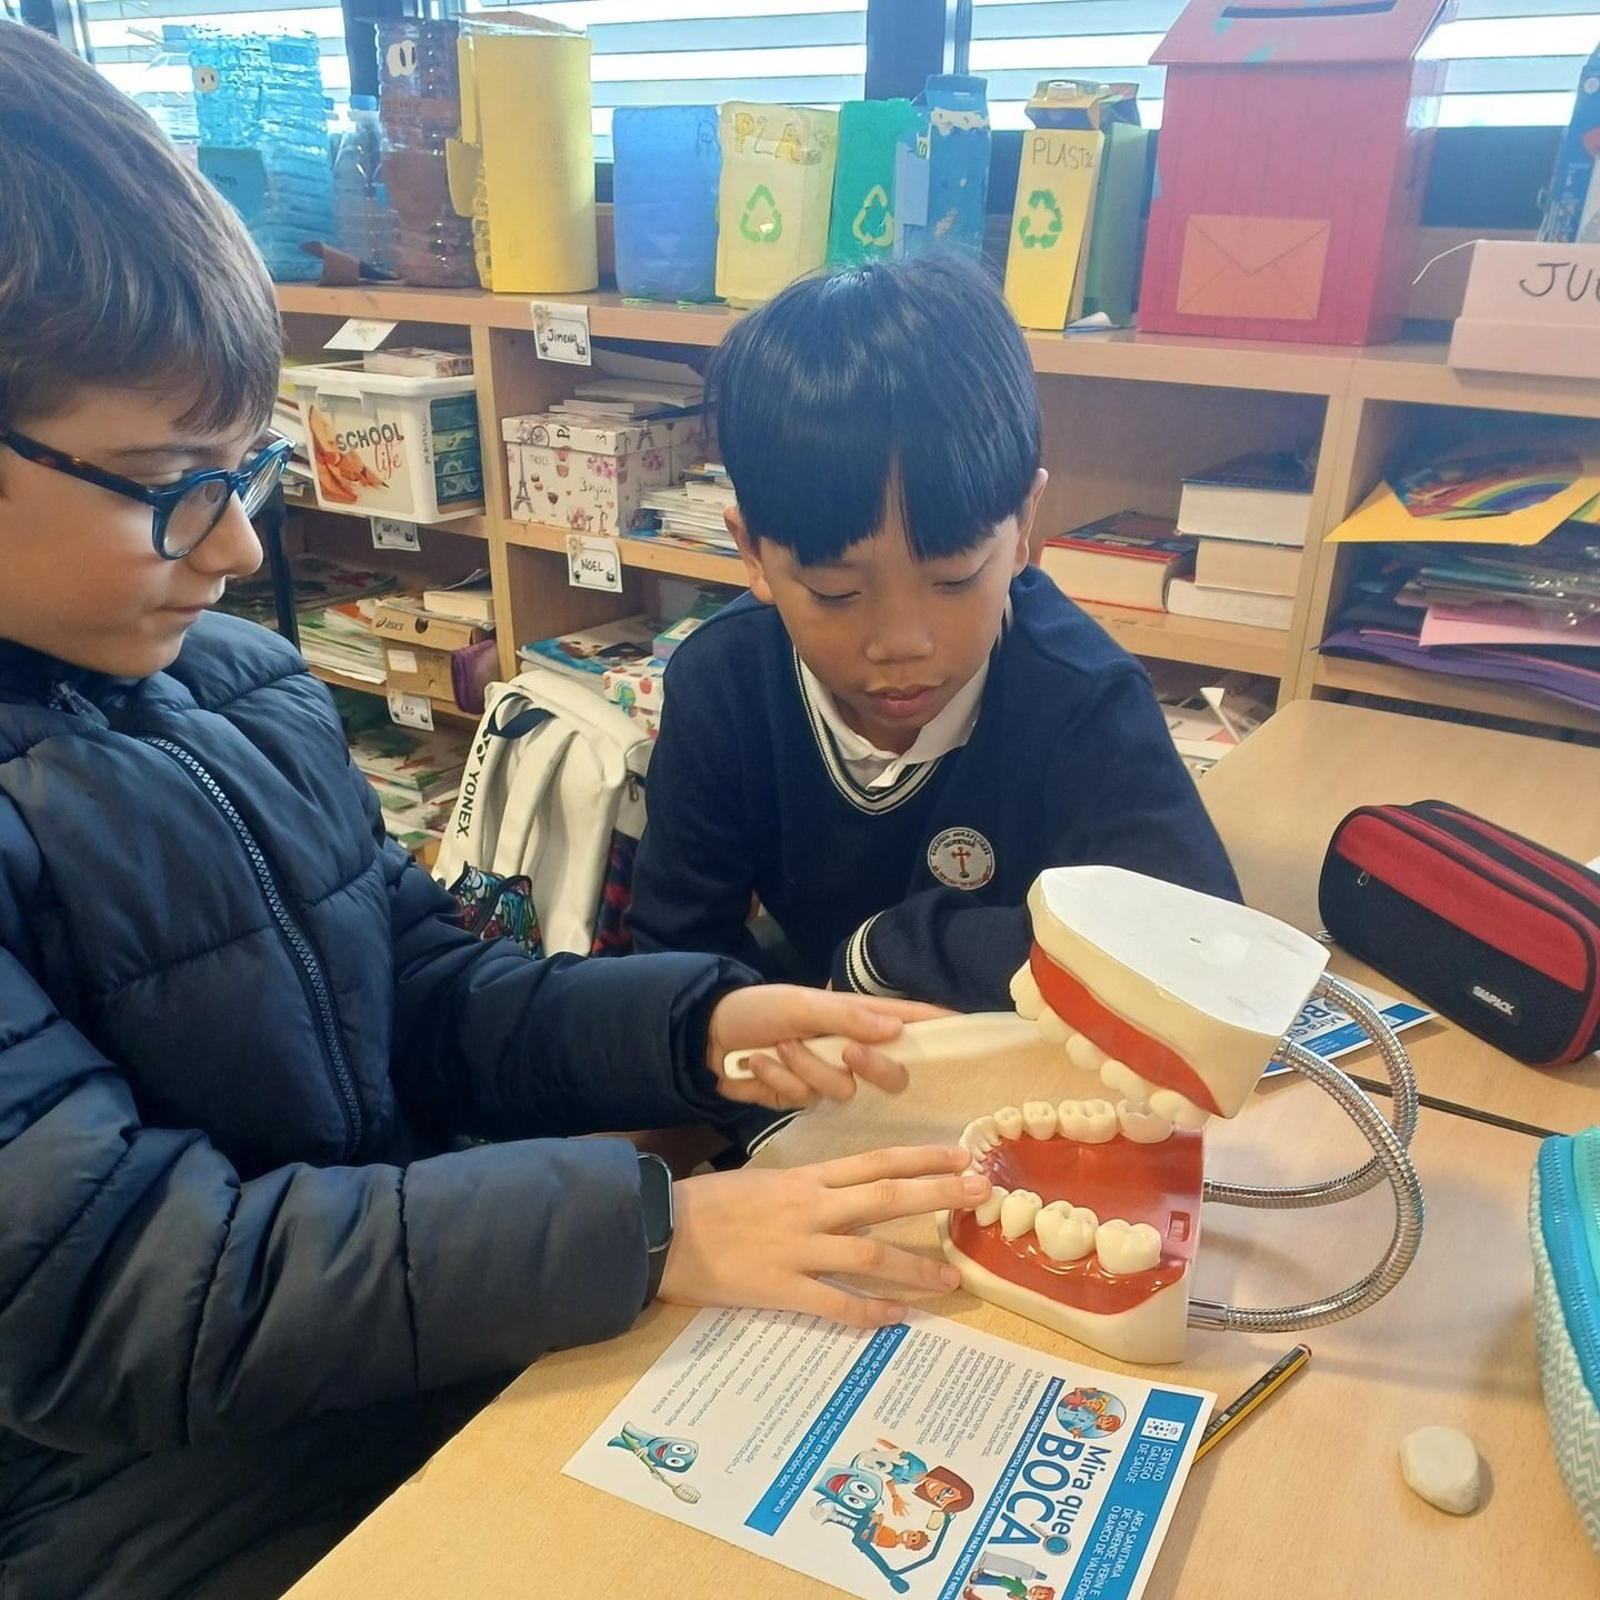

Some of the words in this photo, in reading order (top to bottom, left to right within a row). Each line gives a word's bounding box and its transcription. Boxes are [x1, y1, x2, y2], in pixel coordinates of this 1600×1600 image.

[1519, 262, 1600, 302] JU
[335, 422, 405, 451] SCHOOL
[374, 443, 401, 480] life
[581, 558, 604, 573] NOEL
[456, 769, 480, 838] YONEX
[1308, 1014, 1345, 1031] Mira
[874, 1333, 898, 1360] programa
[857, 1368, 876, 1387] Saúde
[869, 1360, 881, 1369] de
[835, 1386, 863, 1421] Bucodental
[819, 1420, 841, 1444] Infantil
[813, 1443, 823, 1453] en
[1136, 1442, 1149, 1455] DE
[1139, 1444, 1160, 1480] GALEGO
[792, 1453, 819, 1483] Atención
[1071, 1445, 1111, 1490] Mira
[1124, 1454, 1144, 1484] SAÚDE
[1151, 1446, 1173, 1481] SERVIZO
[772, 1483, 798, 1513] Primaria
[988, 1432, 1084, 1545] BOCA
[1051, 1494, 1083, 1535] que
[1110, 1504, 1120, 1513] O
[1120, 1507, 1133, 1519] DE
[1128, 1510, 1147, 1533] ÁREA
[1098, 1512, 1117, 1543] BARCO
[1102, 1519, 1128, 1560] OURENSE,
[1092, 1542, 1105, 1555] DE
[1109, 1532, 1135, 1579] SANITARIA
[1092, 1561, 1111, 1589] VERÍN
